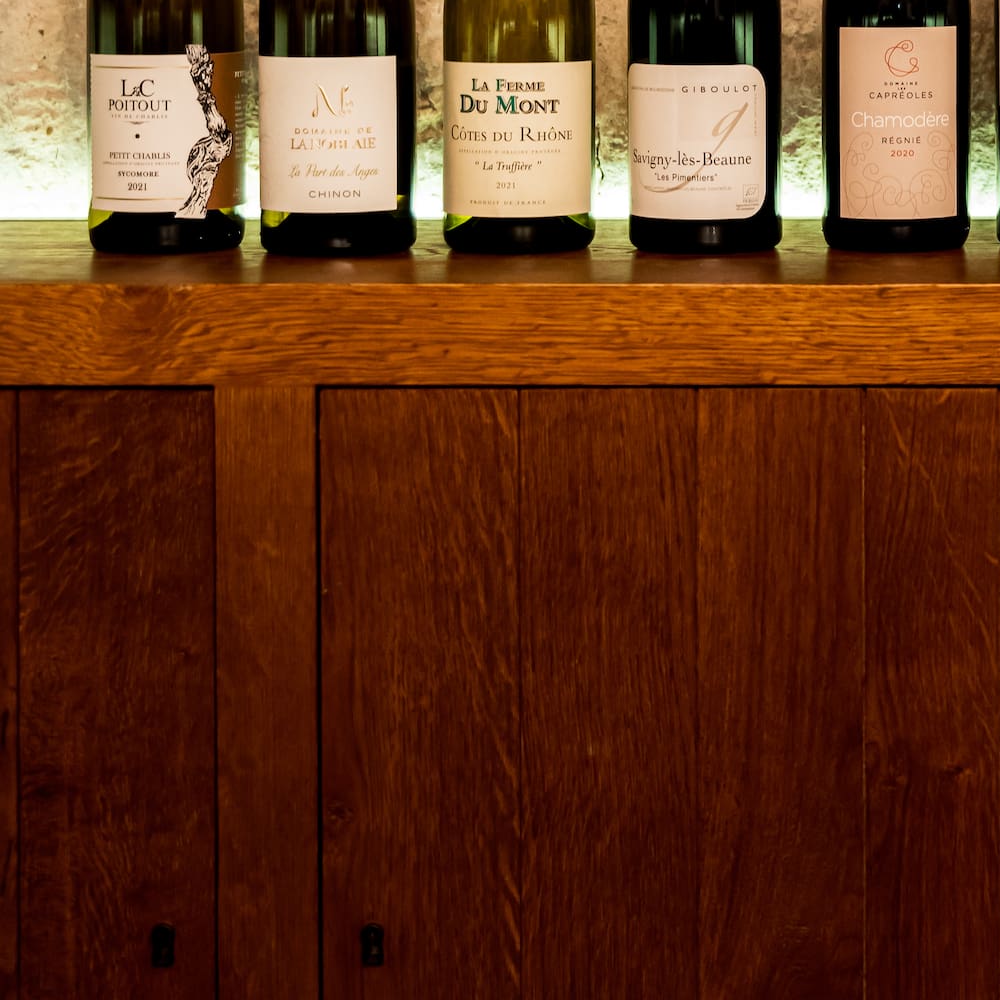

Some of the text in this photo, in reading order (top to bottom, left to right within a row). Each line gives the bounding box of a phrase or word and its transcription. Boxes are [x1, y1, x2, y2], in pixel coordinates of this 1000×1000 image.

[681, 84, 757, 94] GIBOULOT
[869, 90, 934, 100] CAPRÉOLES
[108, 98, 172, 111] POITOUT
[851, 111, 950, 128] Chamodère
[881, 136, 921, 144] RÉGNIÉ
[109, 151, 171, 160] PETIT CHABLIS
[632, 148, 752, 170] Savigny-lès-Beaune
[127, 182, 148, 191] 2021
[308, 189, 361, 199] CHINON
